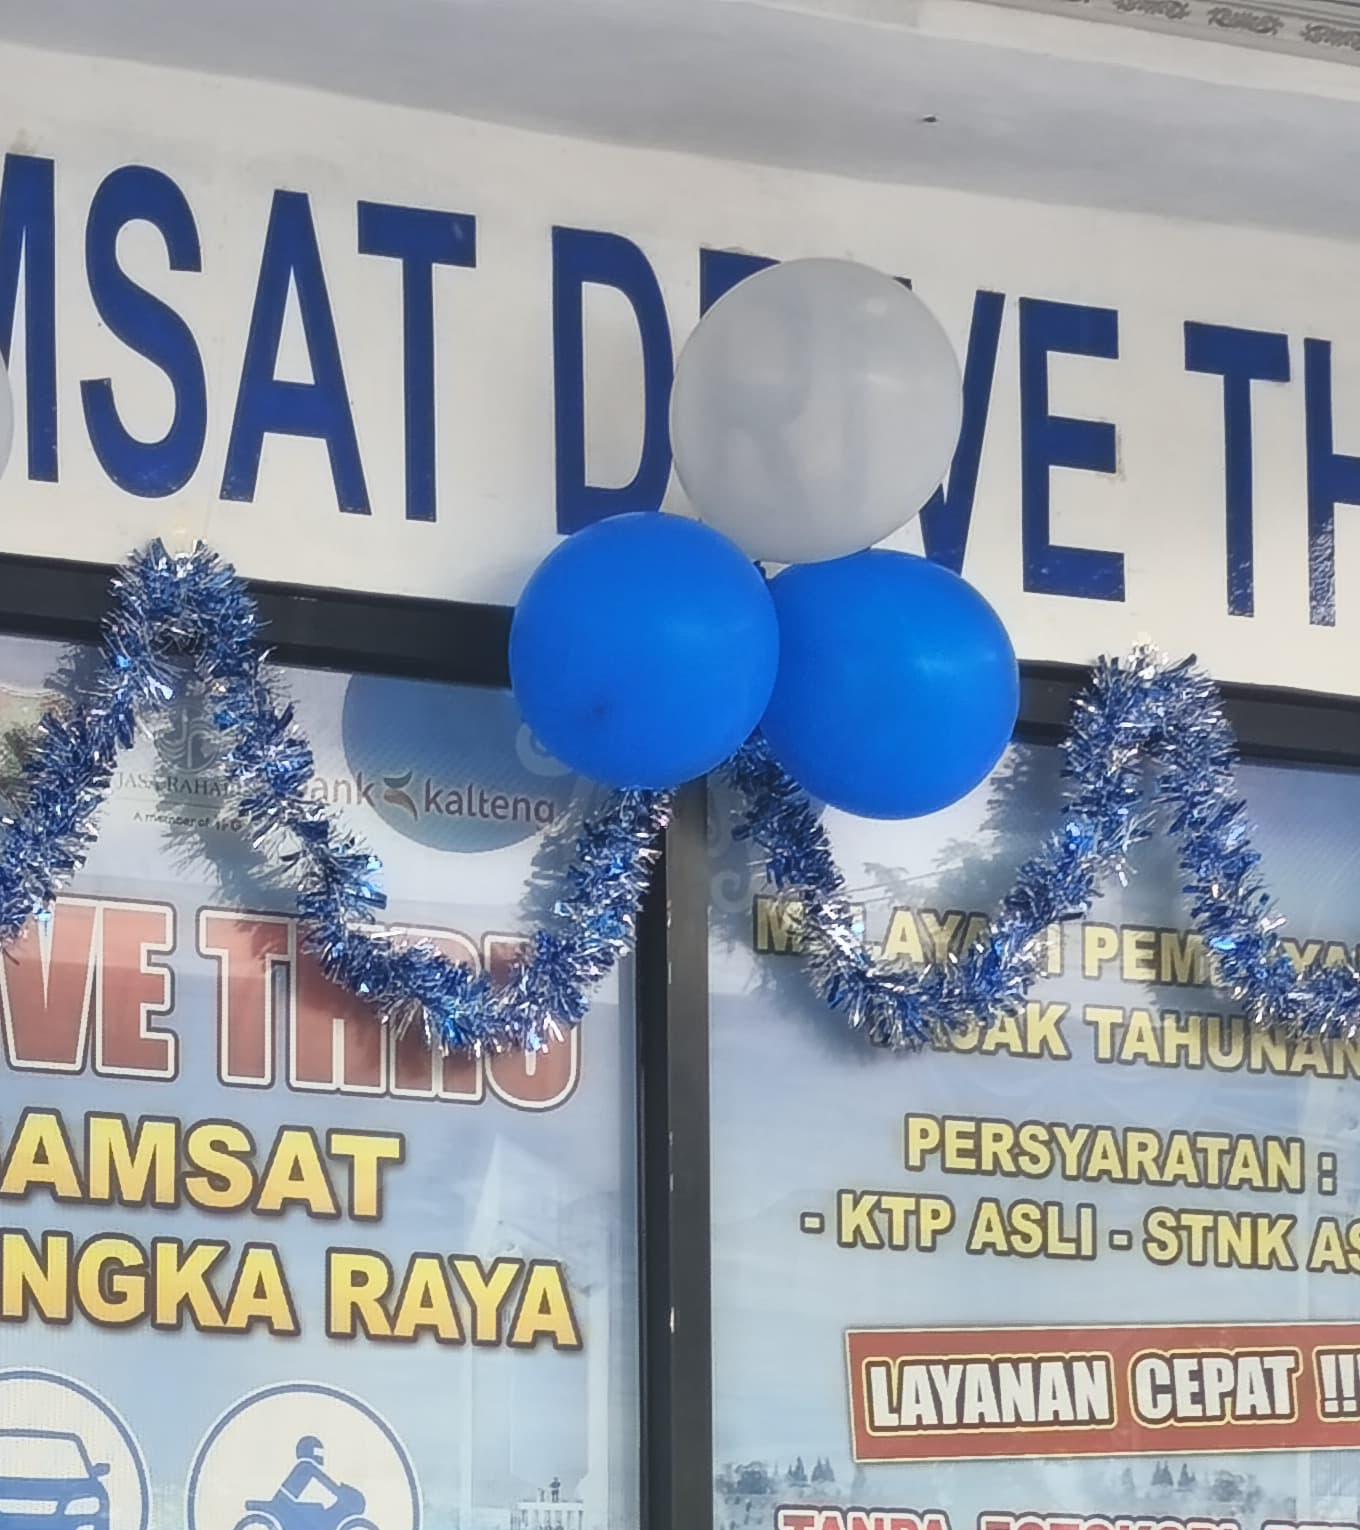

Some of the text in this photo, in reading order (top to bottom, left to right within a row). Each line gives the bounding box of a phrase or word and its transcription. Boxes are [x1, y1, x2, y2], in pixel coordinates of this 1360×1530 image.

[303, 771, 376, 809] ank
[902, 1112, 1311, 1192] PERSYARATAN
[836, 1192, 956, 1251] KTP
[968, 1200, 1098, 1260] ASLI
[1142, 1207, 1296, 1274] STNK
[325, 1247, 582, 1351] RAYA
[866, 1354, 1111, 1428] LAYANAN
[1133, 1353, 1296, 1421] CEPAT
